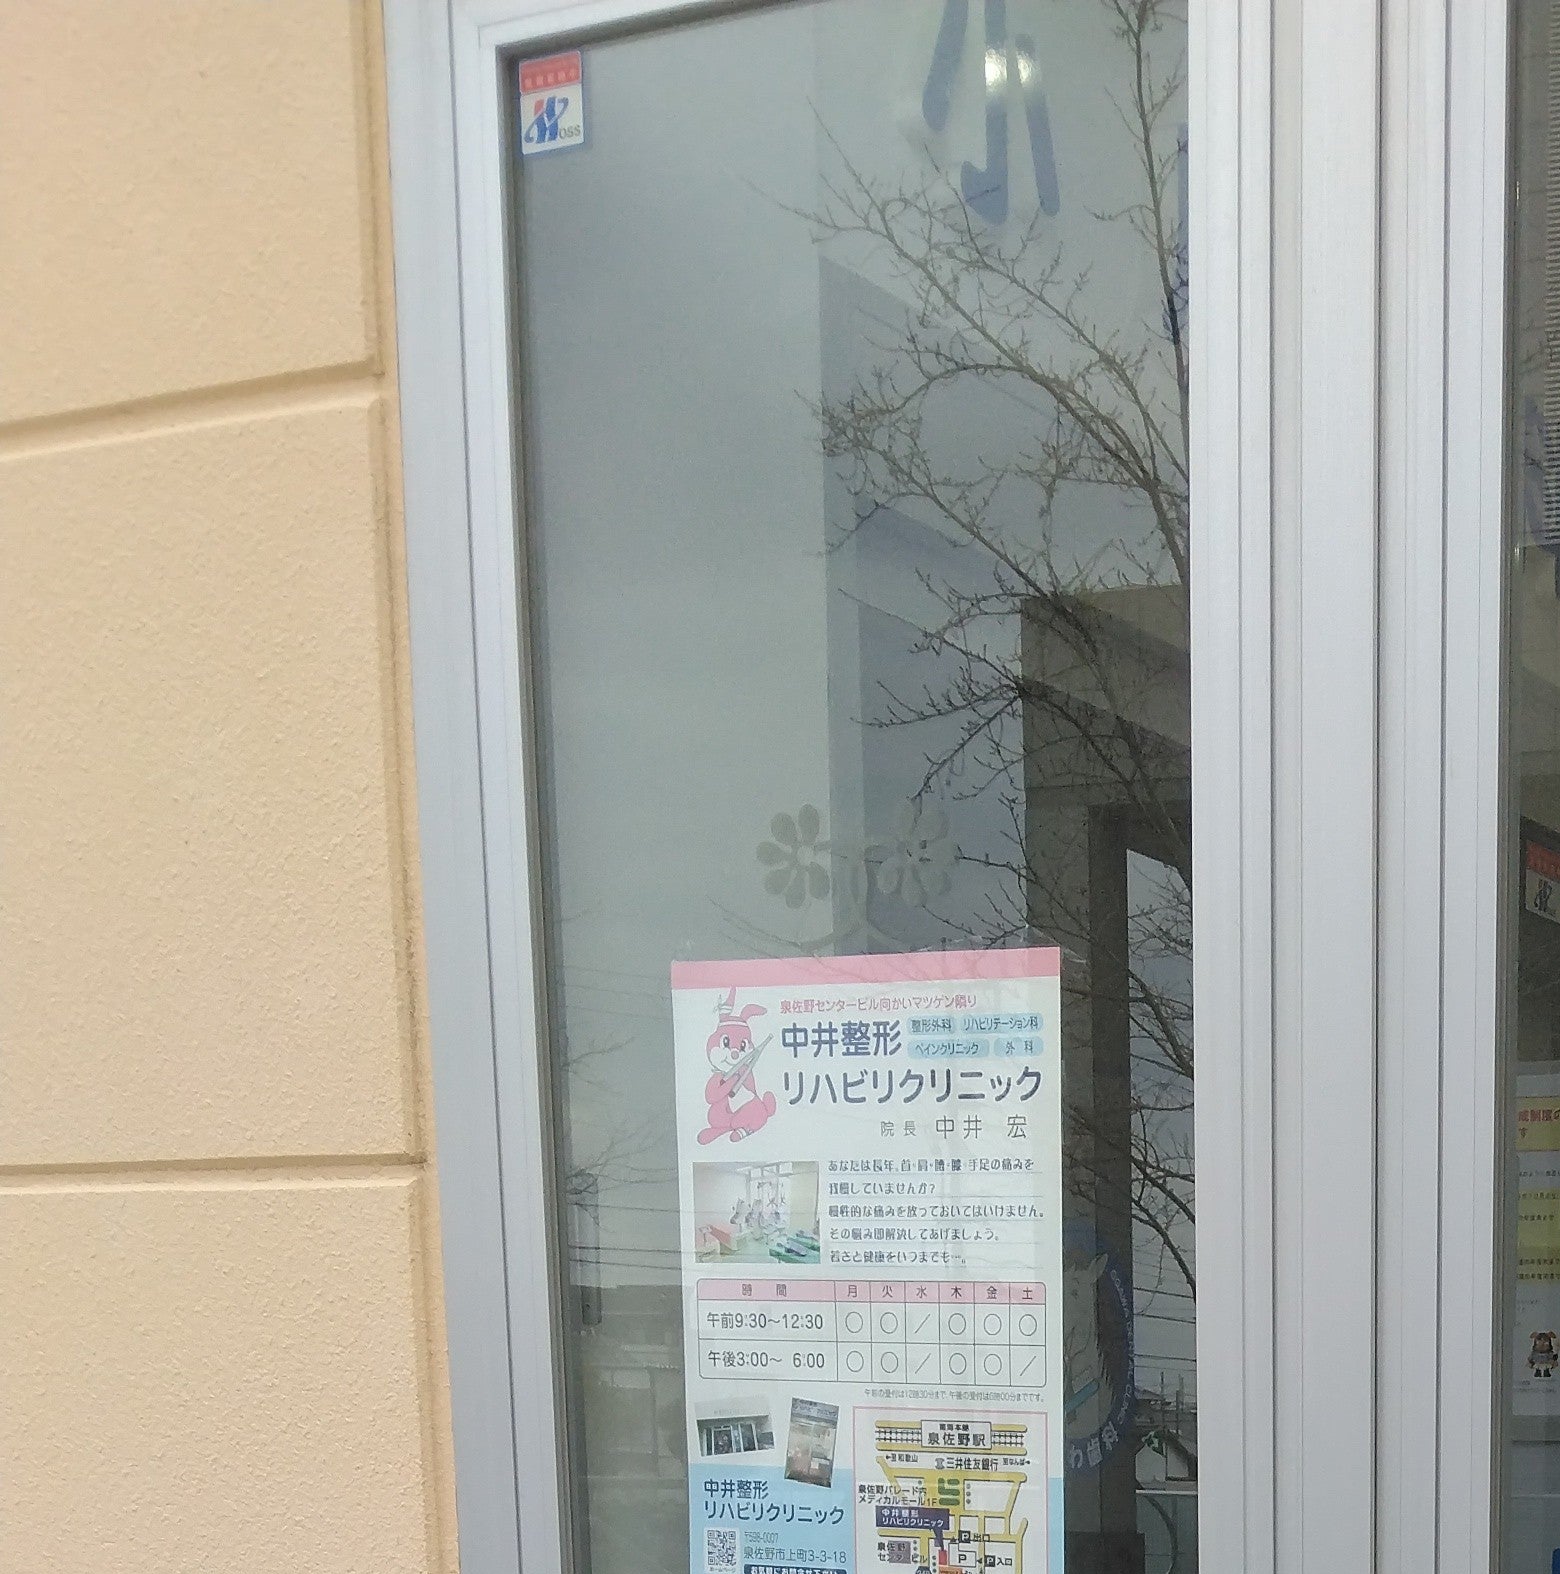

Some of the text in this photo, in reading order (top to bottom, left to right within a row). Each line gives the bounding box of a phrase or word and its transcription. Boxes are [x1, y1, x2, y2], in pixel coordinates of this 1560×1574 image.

[911, 1018, 952, 1033] 整形外科
[963, 1016, 1039, 1031] リハビリテーション科
[781, 1019, 902, 1058] 中井整形
[782, 1066, 1042, 1105] リハビリクリニック
[847, 1285, 858, 1297] 月
[882, 1285, 893, 1297] 火
[916, 1285, 928, 1298] 水
[950, 1286, 962, 1298] 木
[986, 1286, 998, 1298] 金
[1022, 1287, 1034, 1299] 土
[928, 1433, 985, 1447] 泉佐野駅
[703, 1479, 769, 1500] 中井整形
[704, 1500, 845, 1525] リハビリクリニック
[743, 1545, 847, 1563] 泉佐野市上町3-3-18
